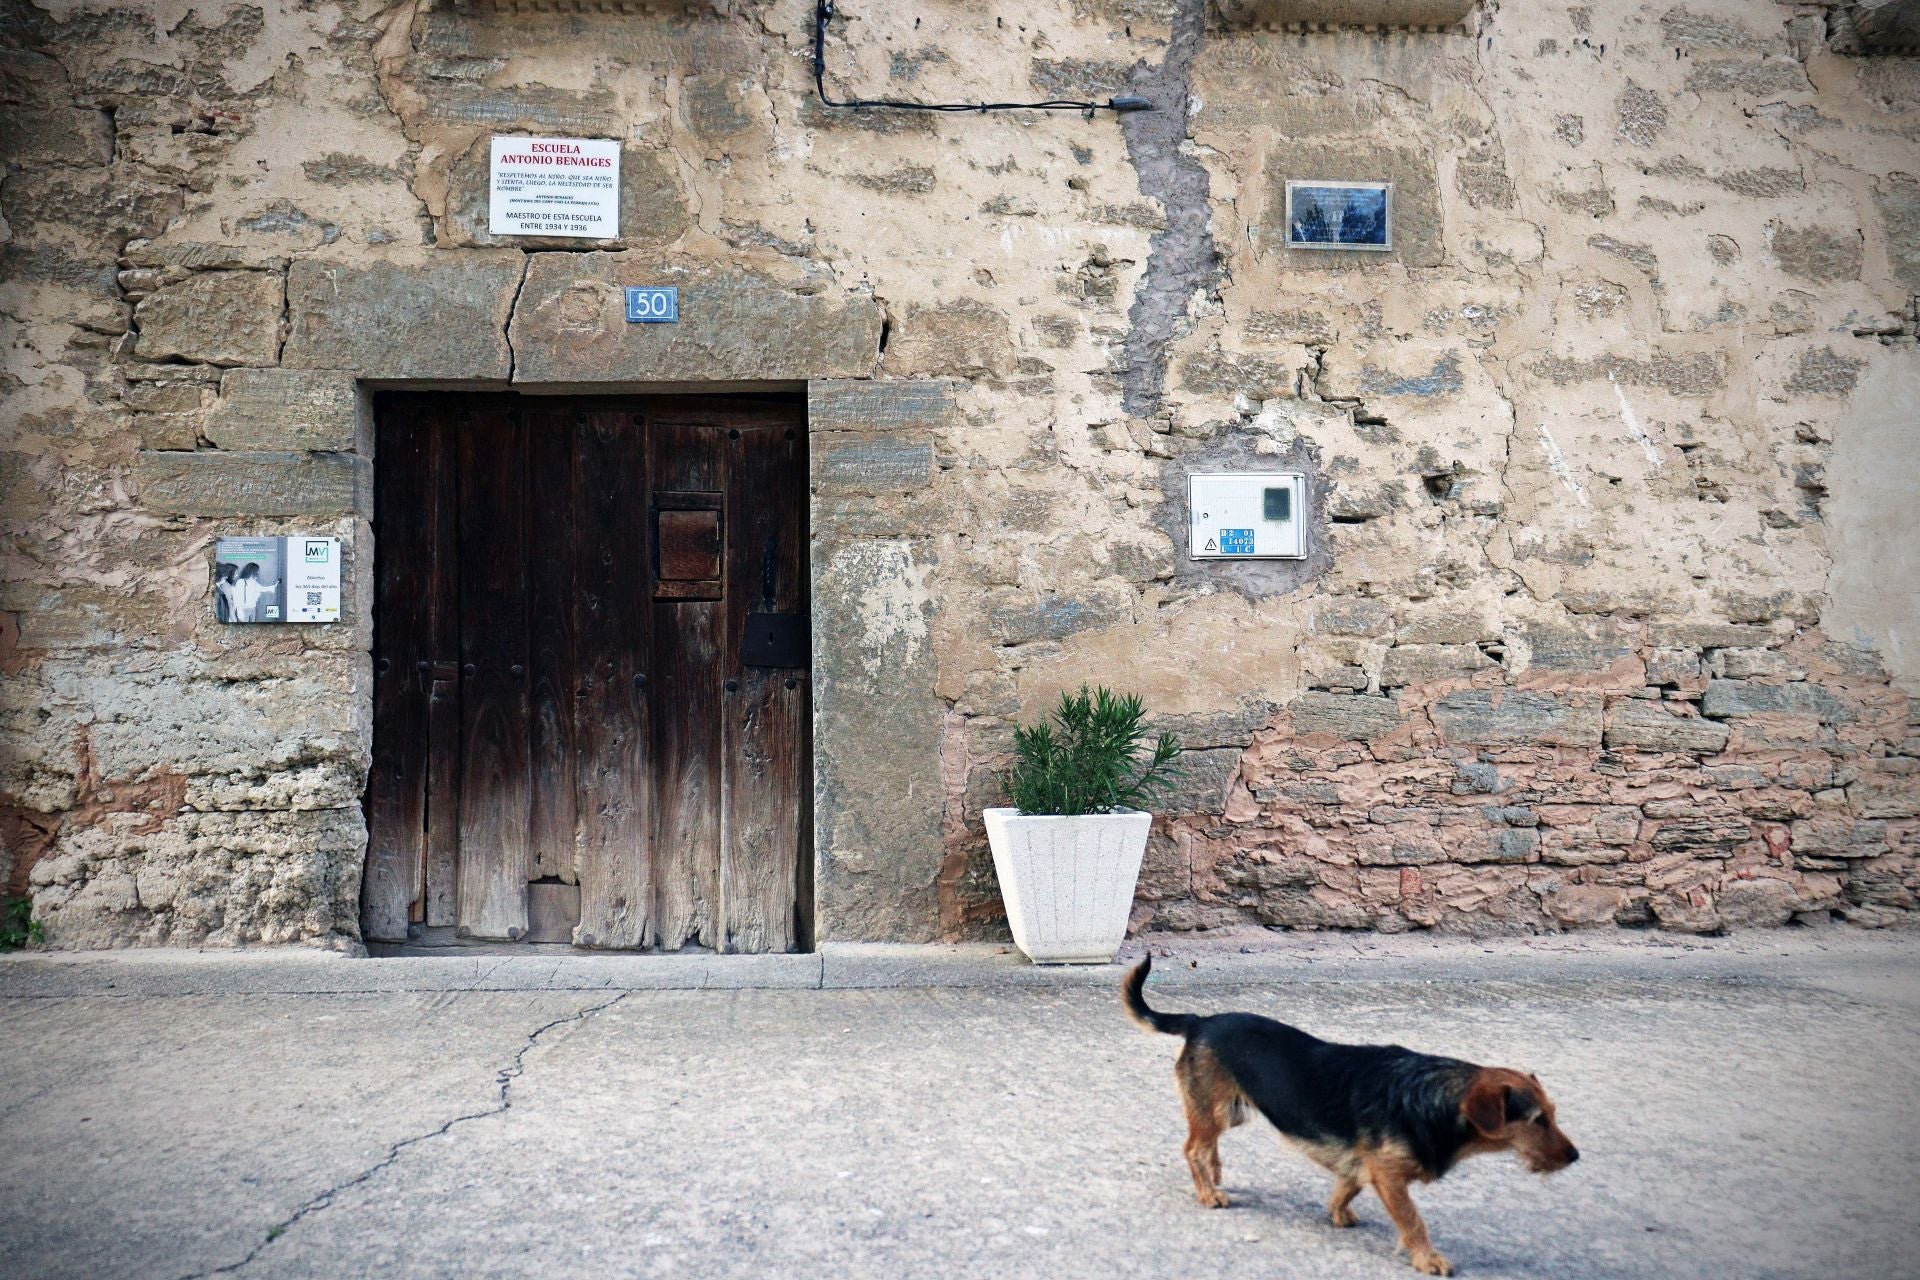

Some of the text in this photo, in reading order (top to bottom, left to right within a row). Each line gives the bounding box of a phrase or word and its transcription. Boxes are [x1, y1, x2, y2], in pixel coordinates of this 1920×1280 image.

[532, 144, 580, 154] ESCUELA
[500, 154, 611, 167] ANTONIO BENAIGES
[636, 293, 666, 315] 50
